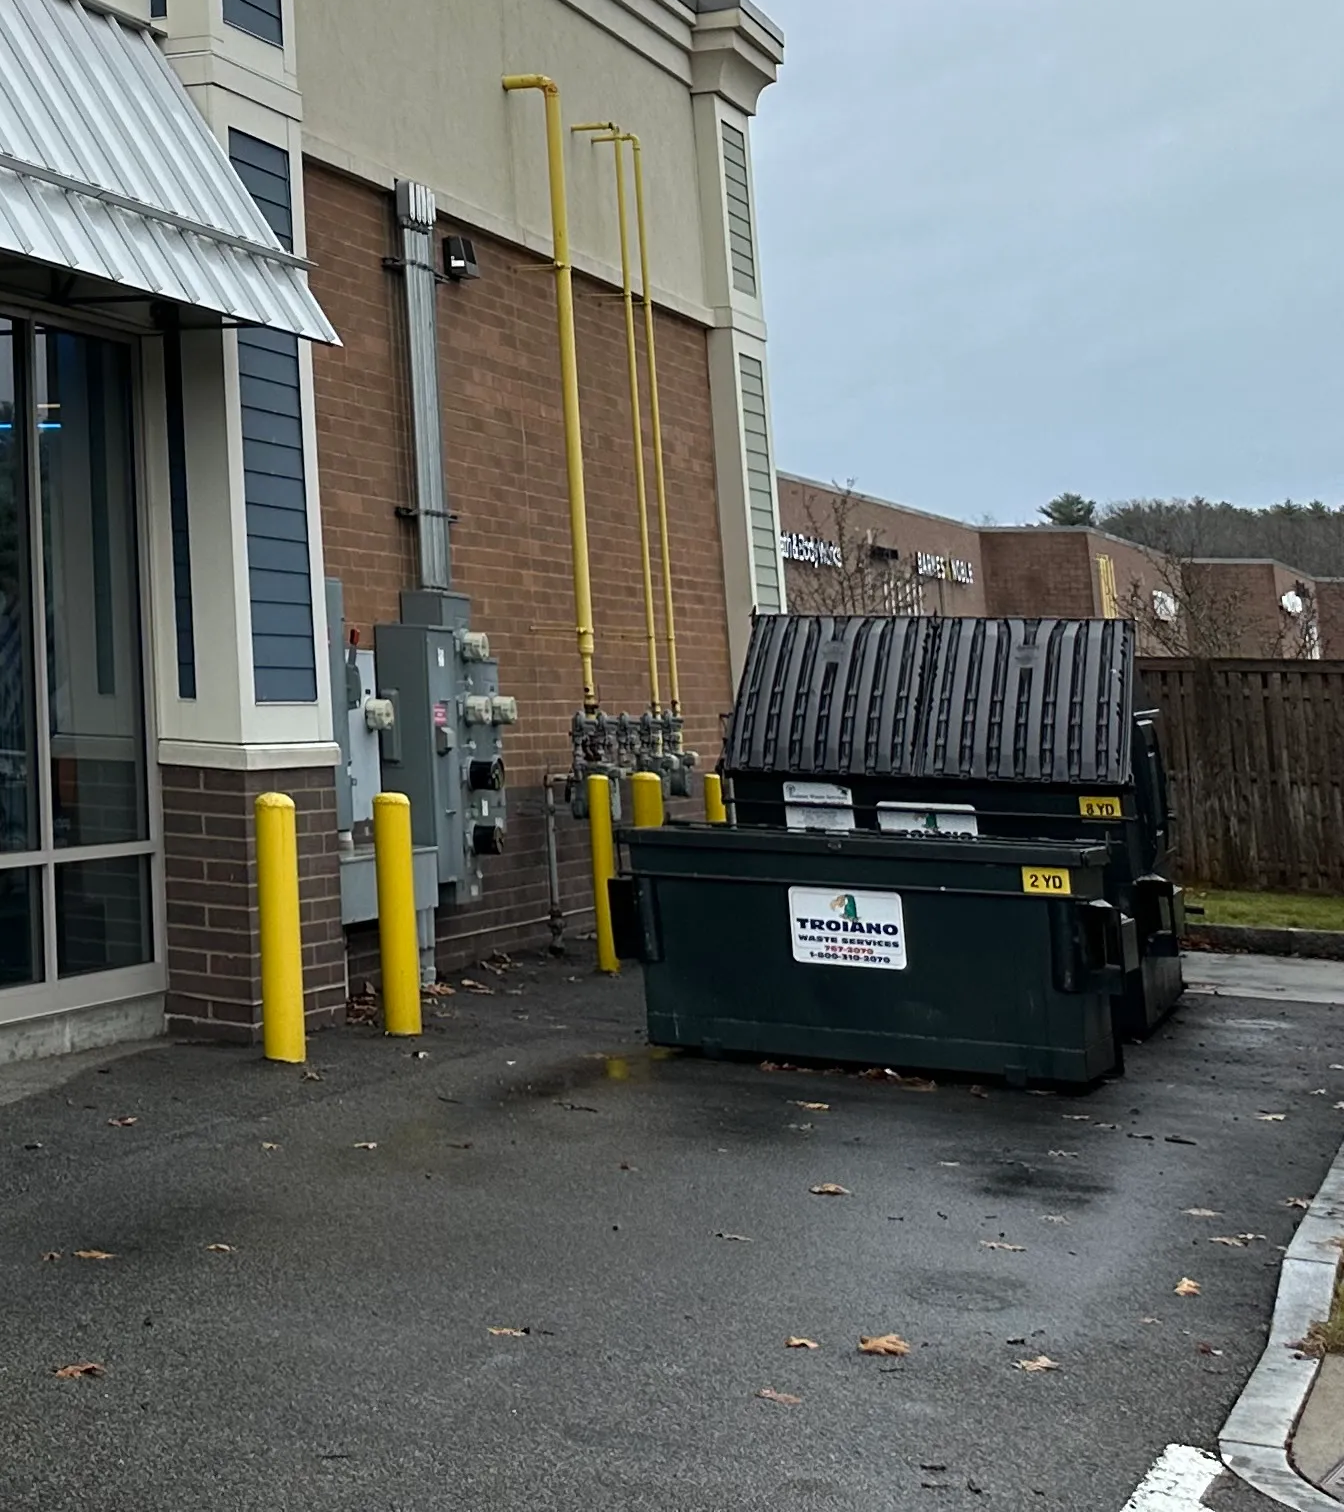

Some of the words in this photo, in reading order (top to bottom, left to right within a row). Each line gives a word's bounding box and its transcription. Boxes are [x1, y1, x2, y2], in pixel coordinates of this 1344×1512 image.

[1096, 803, 1115, 817] YD
[1029, 873, 1040, 888] 2
[1041, 874, 1063, 889] YD
[796, 917, 899, 936] TROIANO
[798, 934, 838, 944] WASTE
[841, 937, 900, 949] SERVICES
